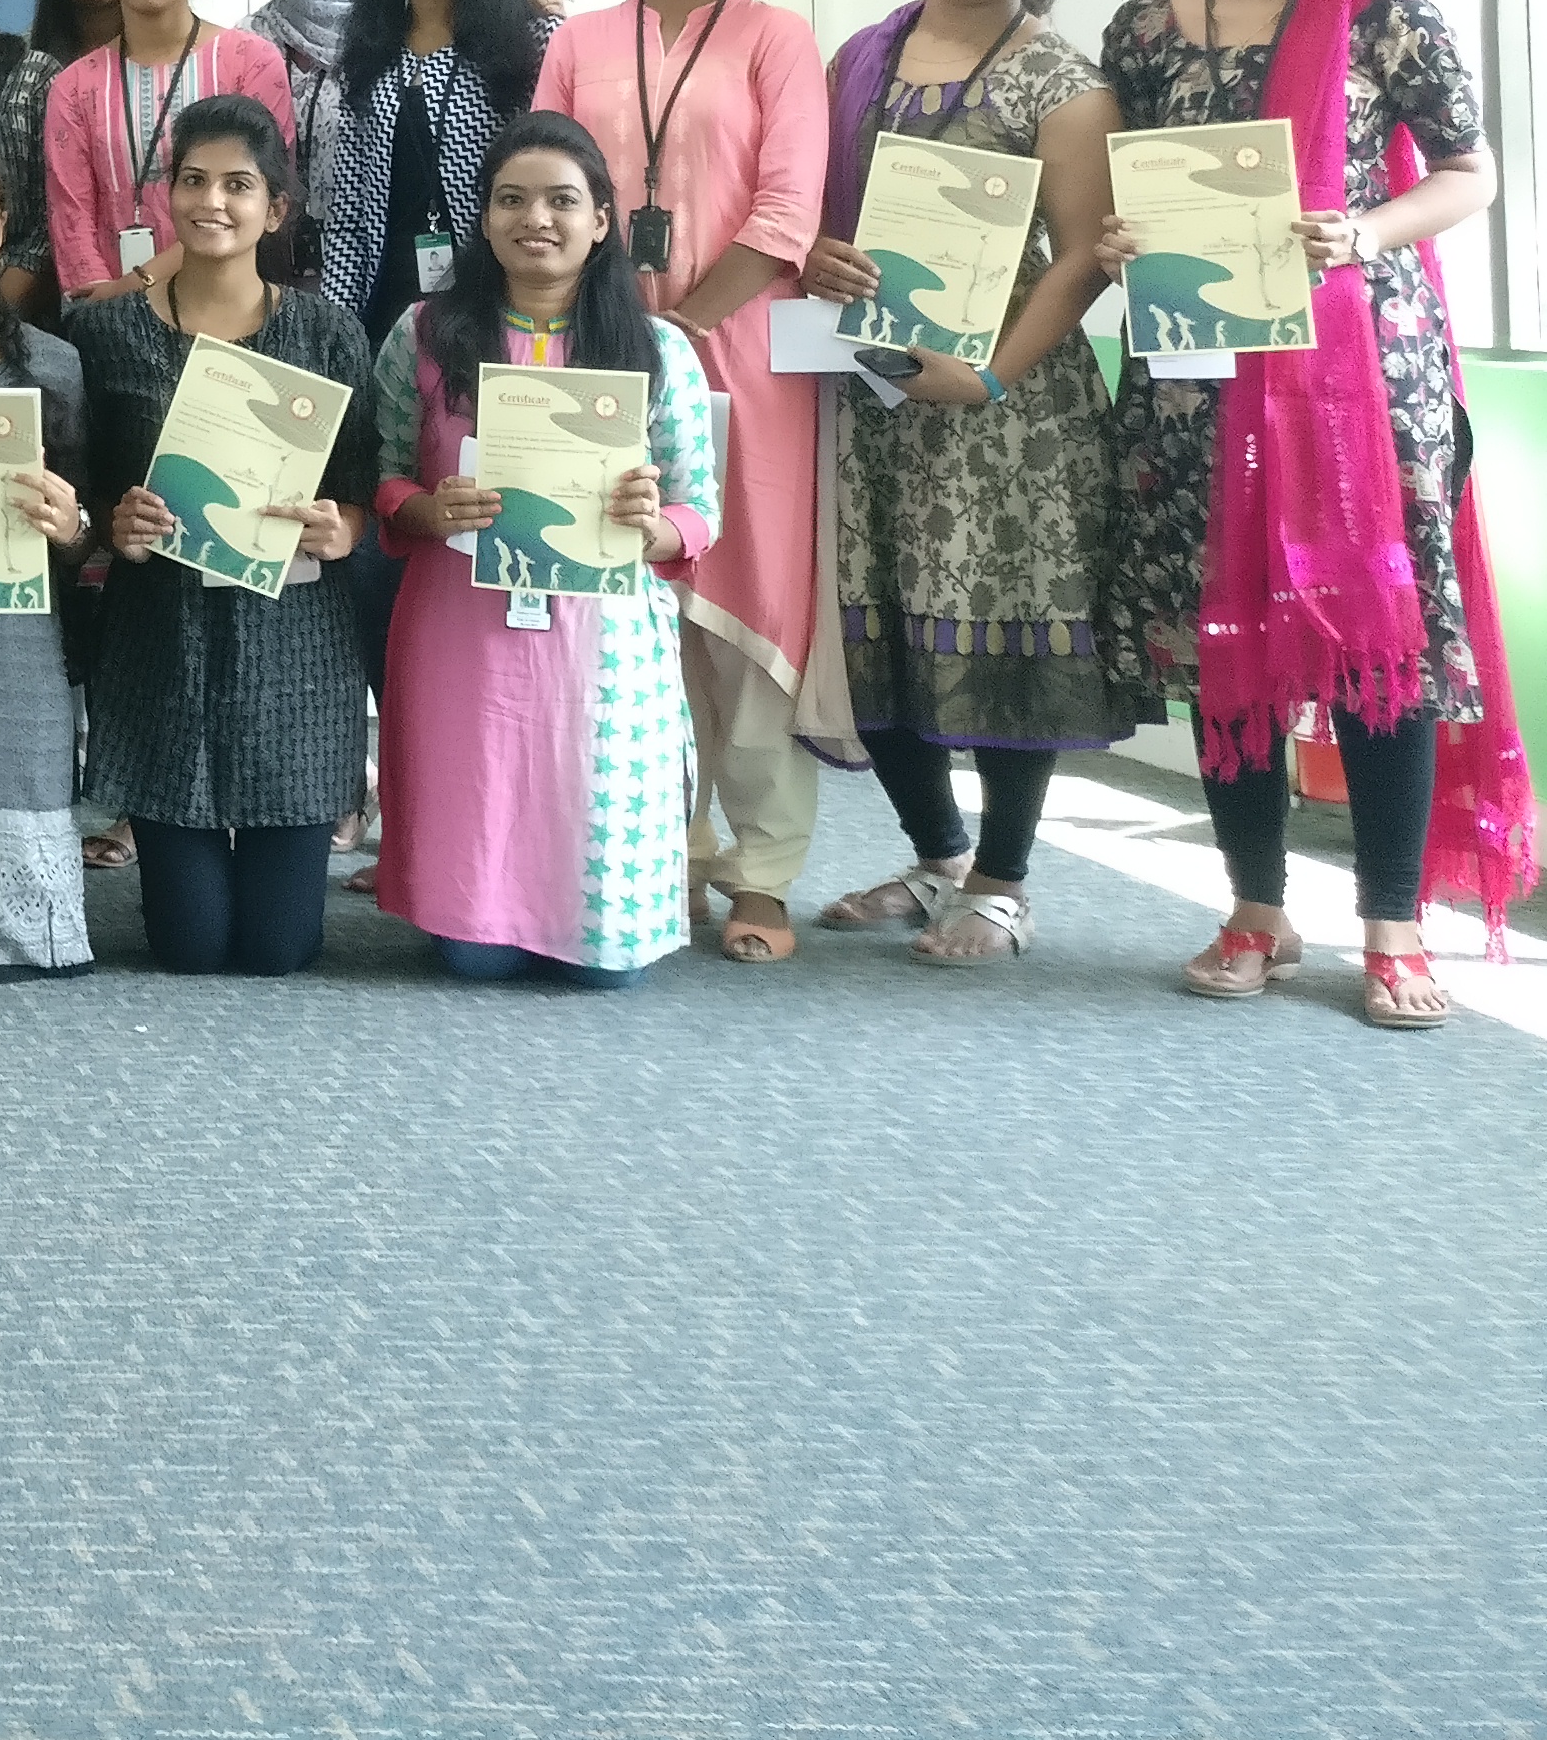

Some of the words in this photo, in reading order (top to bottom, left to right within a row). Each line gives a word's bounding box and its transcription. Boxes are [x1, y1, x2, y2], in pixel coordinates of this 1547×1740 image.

[891, 161, 941, 177] Certificate
[1131, 157, 1186, 170] Certificate
[205, 367, 252, 390] Certificate
[498, 392, 550, 405] Certificate
